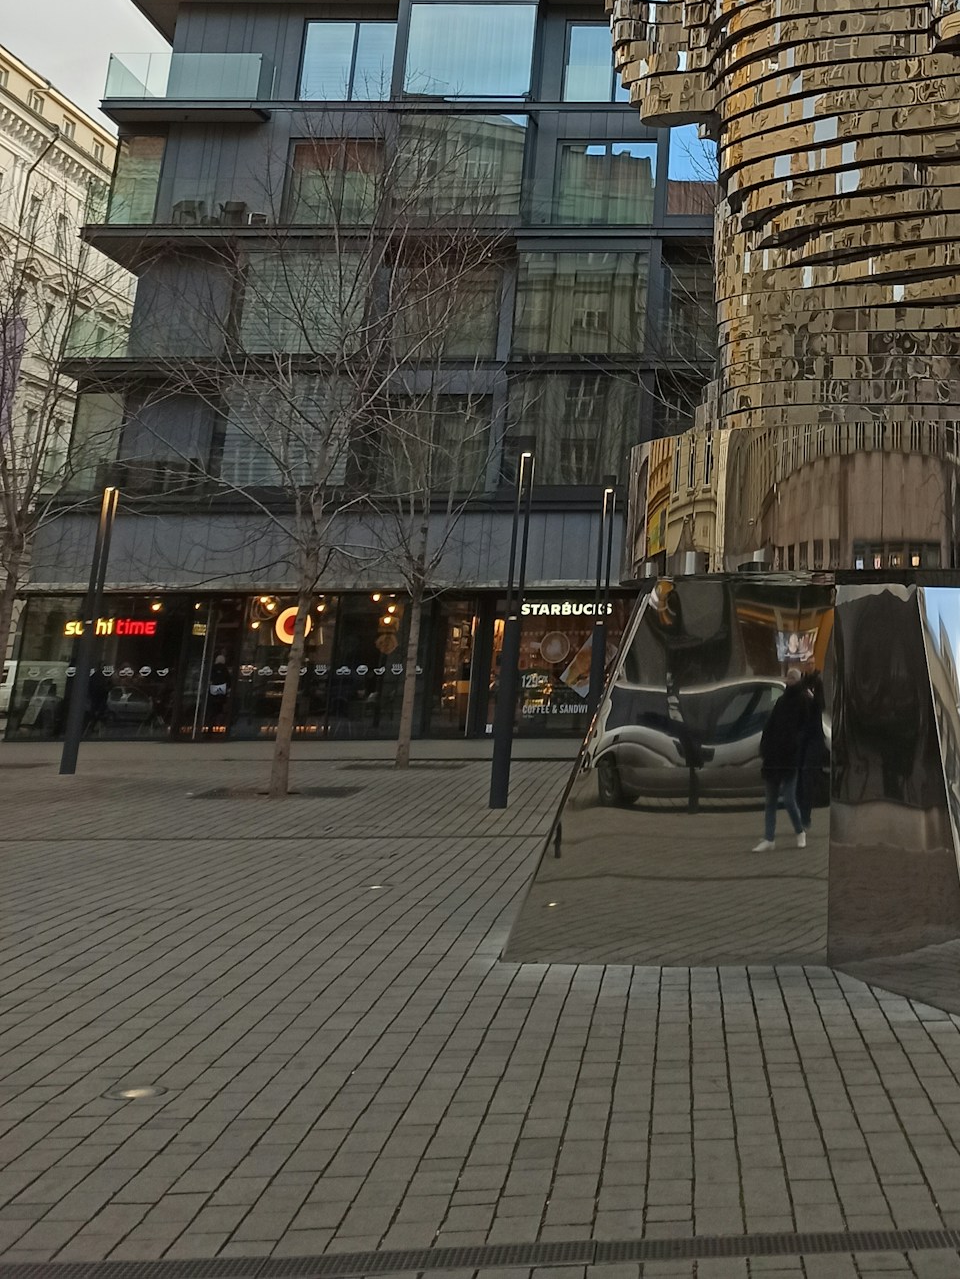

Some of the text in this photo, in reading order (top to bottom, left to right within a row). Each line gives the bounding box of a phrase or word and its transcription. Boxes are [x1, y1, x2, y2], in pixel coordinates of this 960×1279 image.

[64, 618, 157, 635] suhi time
[522, 704, 589, 714] COFFEE & SANDWI
